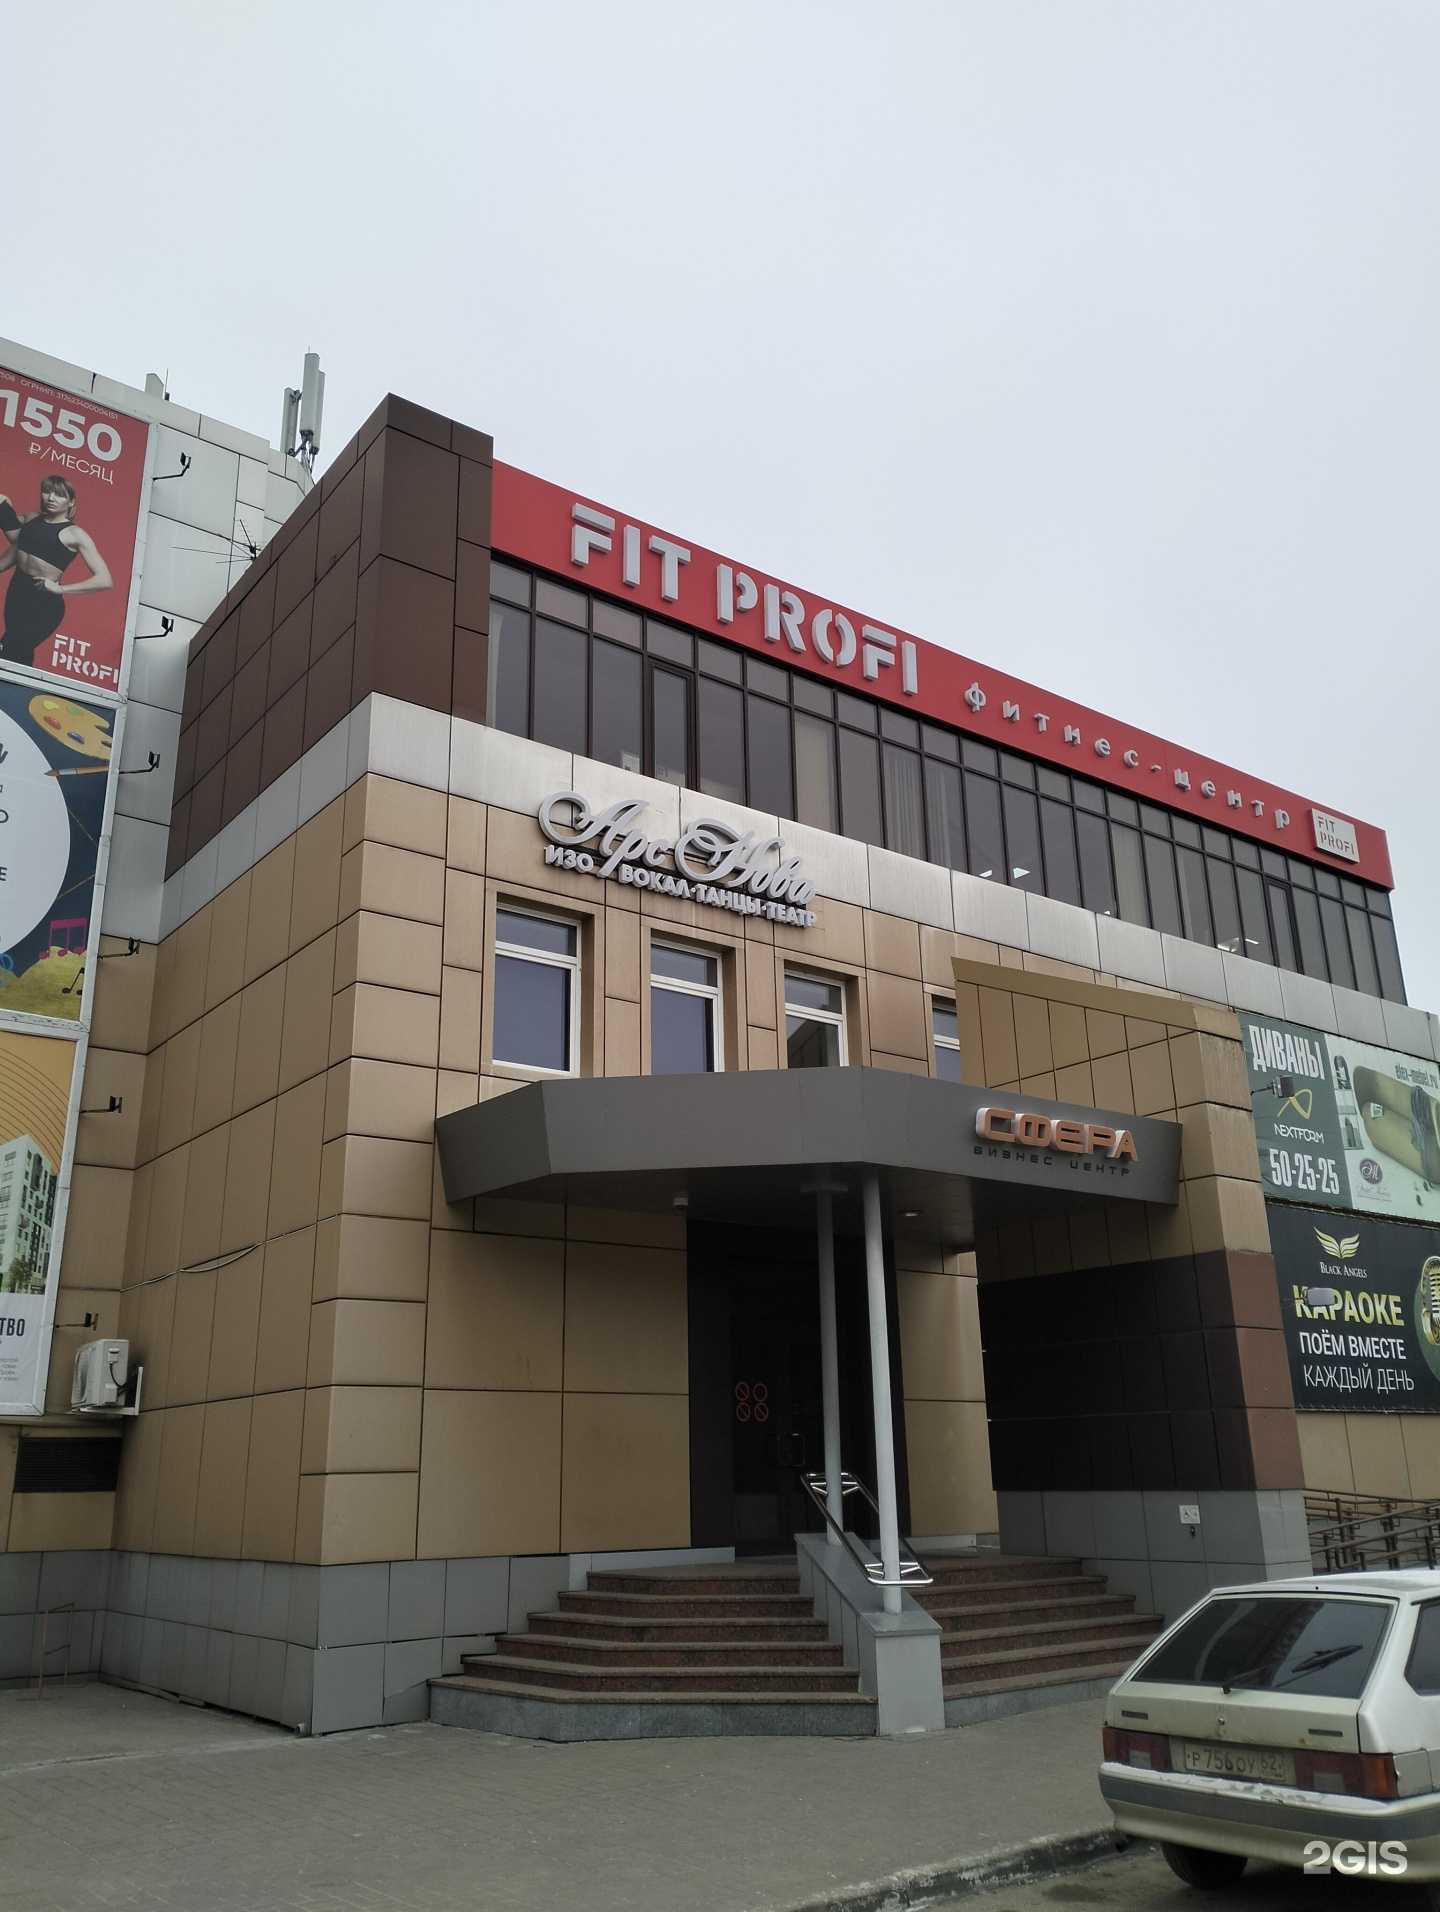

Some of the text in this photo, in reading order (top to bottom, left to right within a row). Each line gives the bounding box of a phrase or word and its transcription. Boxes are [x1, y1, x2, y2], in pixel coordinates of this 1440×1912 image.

[571, 503, 918, 696] FIT PROFI
[54, 634, 91, 656] FIT
[52, 650, 119, 684] PROFI
[1318, 816, 1335, 833] FIT
[544, 844, 594, 873] ИЗО
[1320, 831, 1355, 855] PROFI
[1249, 1025, 1326, 1080] ДИВАНЫ
[975, 1107, 1138, 1161] СФЕРА
[1273, 1123, 1325, 1144] NEXTFORM
[973, 1145, 1131, 1176] БИЗНЕС ЦЕНТР
[1269, 1148, 1340, 1195] 50-25-25
[1300, 1329, 1406, 1360] ПОЁМ ВМЕСТЕ
[1304, 1362, 1415, 1394] КАЖДЫЙ ДЕНЬ
